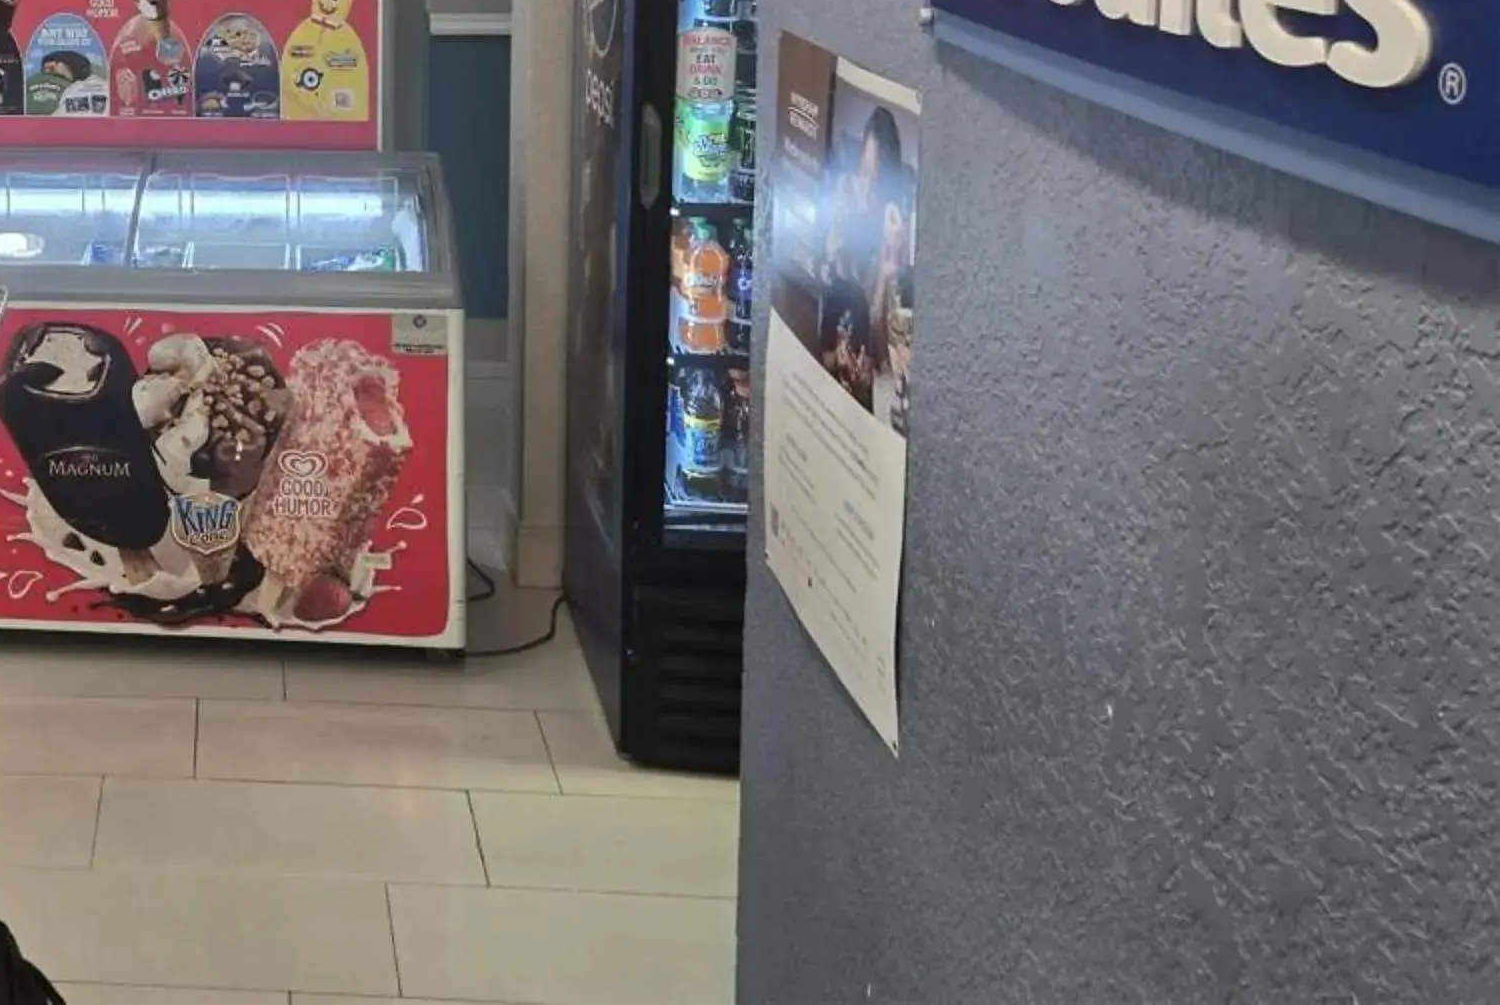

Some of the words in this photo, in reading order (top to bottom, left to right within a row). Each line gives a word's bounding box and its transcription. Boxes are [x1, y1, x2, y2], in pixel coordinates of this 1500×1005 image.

[586, 68, 614, 129] pepsi
[49, 459, 131, 478] MAGNUM
[281, 479, 324, 497] GOOD
[274, 497, 332, 516] HUMOR
